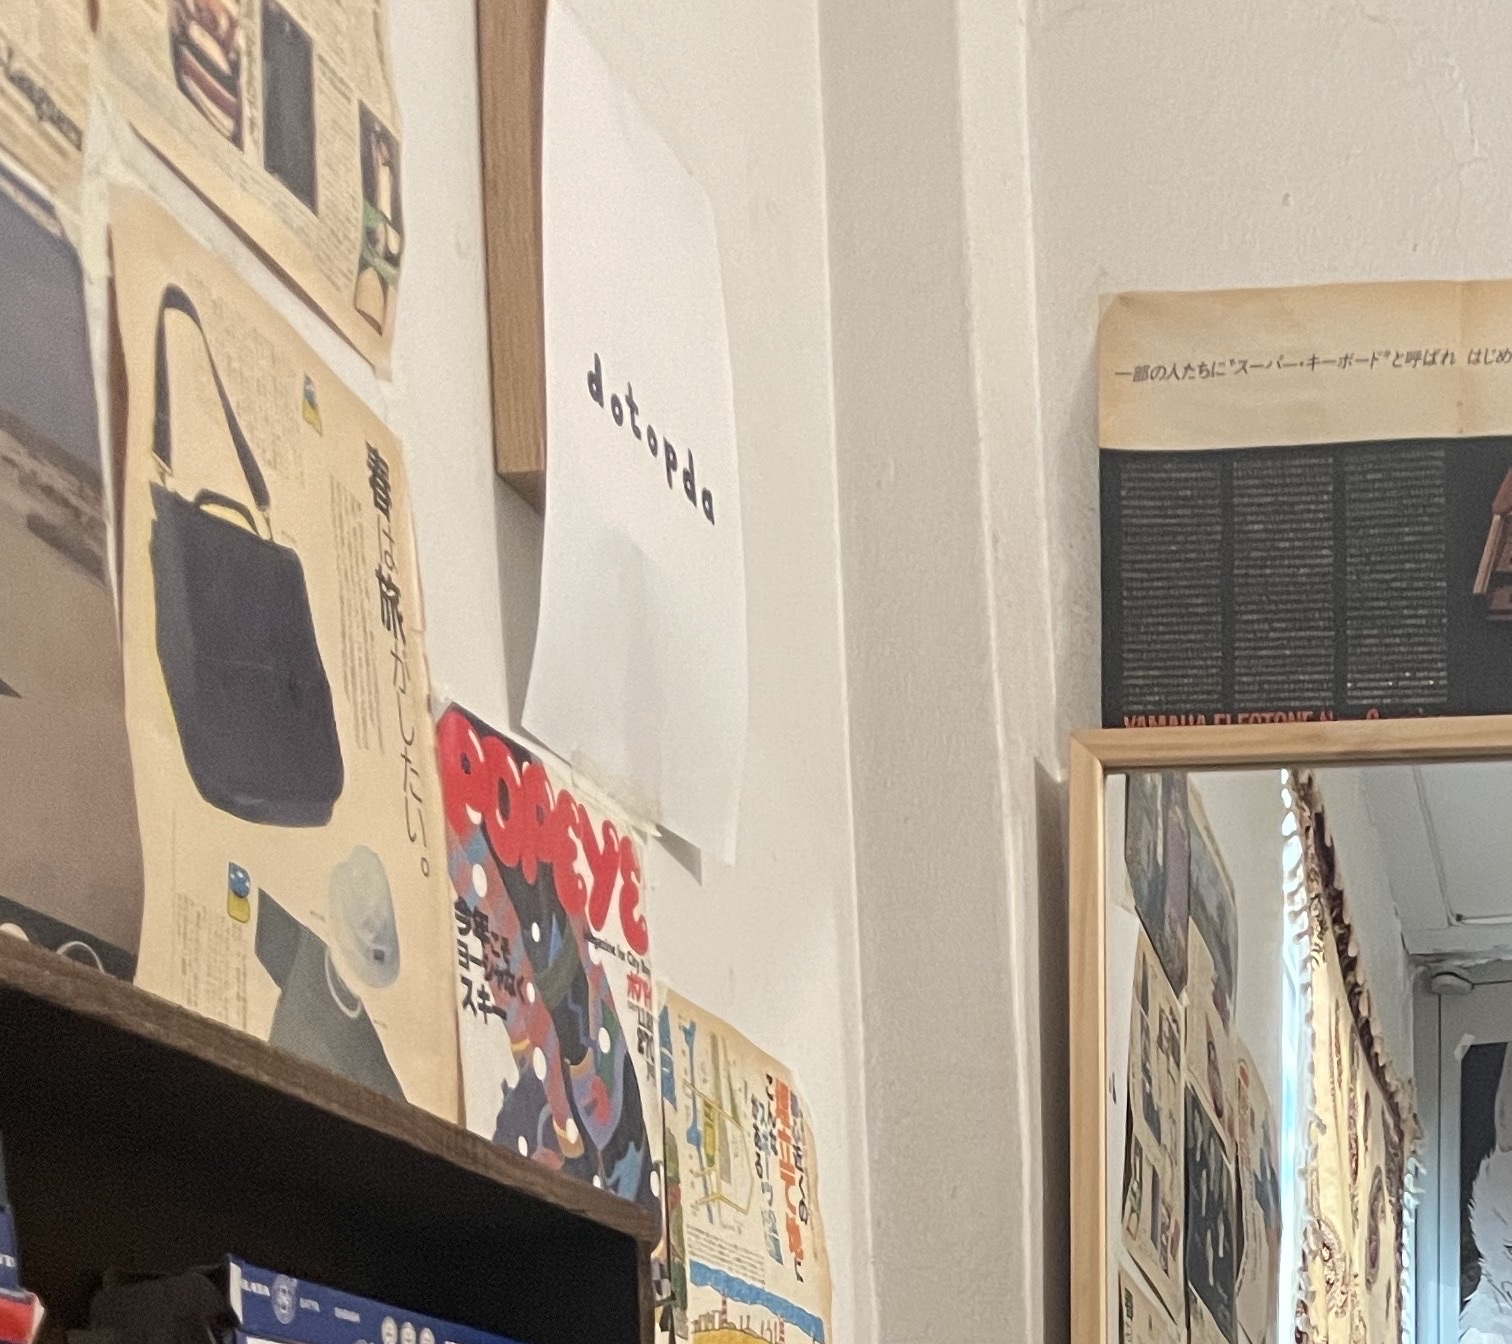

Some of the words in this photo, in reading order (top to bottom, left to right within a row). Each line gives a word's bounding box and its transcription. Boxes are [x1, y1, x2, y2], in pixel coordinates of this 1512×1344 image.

[437, 710, 648, 955] POPEYE
[460, 975, 507, 1025] スキー
